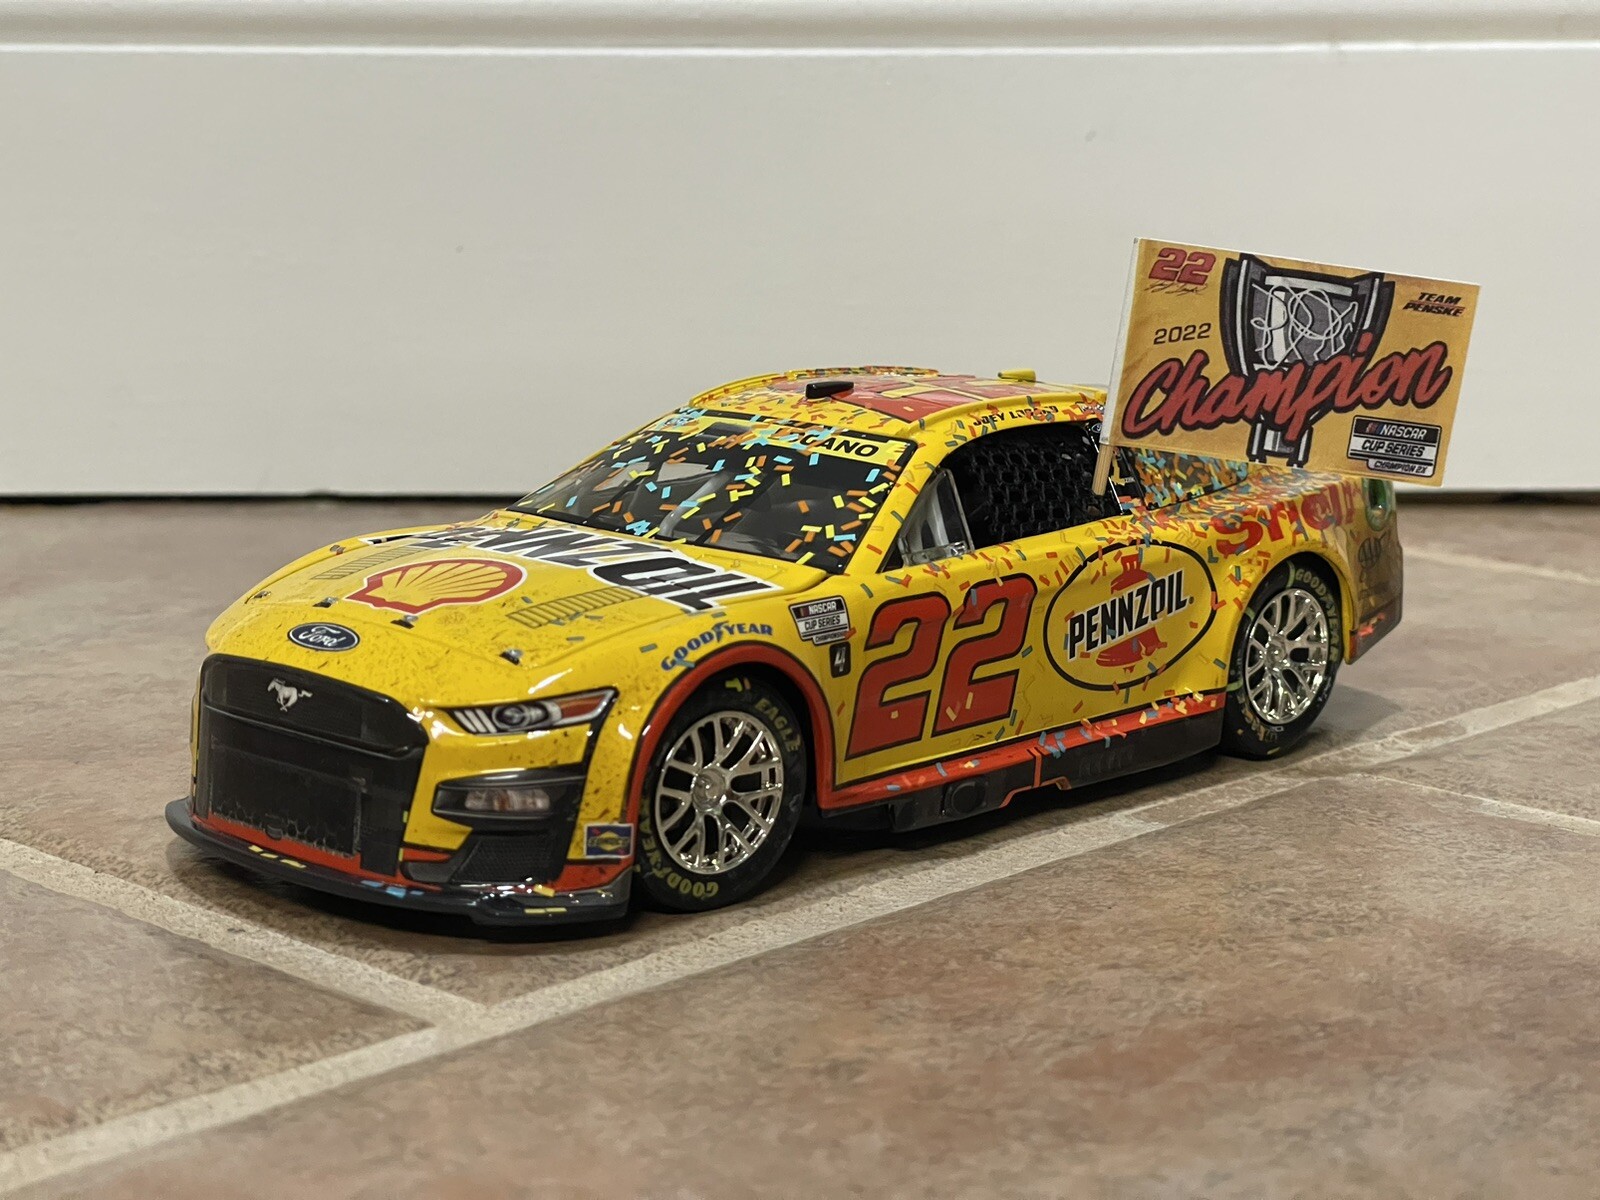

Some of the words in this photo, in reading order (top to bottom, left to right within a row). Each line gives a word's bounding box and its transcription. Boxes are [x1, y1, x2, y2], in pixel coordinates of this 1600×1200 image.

[1149, 248, 1216, 285] 22
[1402, 302, 1466, 317] PENSKE
[1418, 292, 1462, 305] TEAM
[1153, 323, 1211, 345] 2022
[1122, 332, 1452, 442] Champion
[1380, 424, 1428, 440] NASCAR
[1361, 439, 1386, 452] CUP
[1385, 442, 1426, 457] SERIES
[808, 601, 837, 615] NASCAR
[1067, 569, 1190, 660] PENNZOIL
[805, 620, 817, 631] CUP
[818, 615, 841, 628] SERIES
[299, 626, 347, 647] Ford
[661, 620, 773, 671] GOODYEAR
[834, 646, 846, 672] 4
[844, 573, 1038, 761] 22
[755, 698, 802, 752] EAGLE
